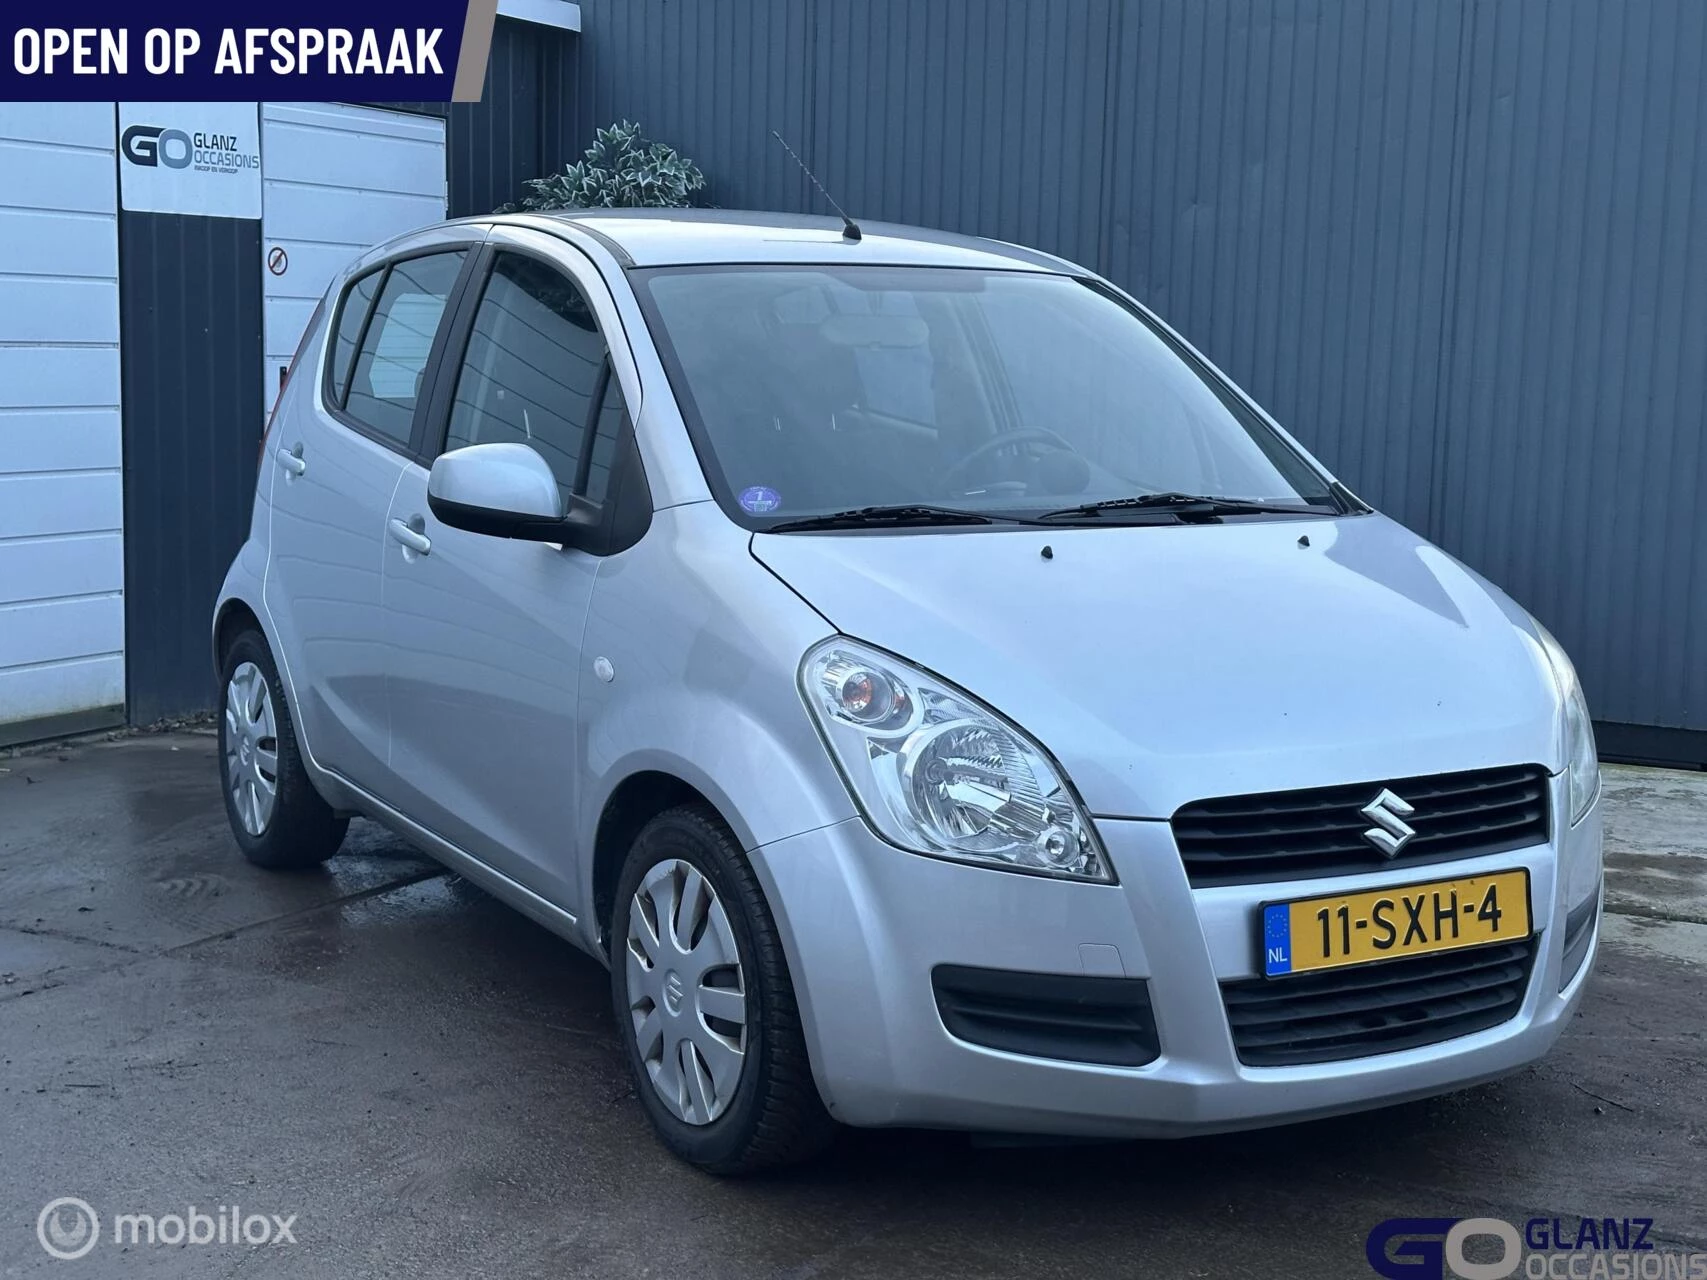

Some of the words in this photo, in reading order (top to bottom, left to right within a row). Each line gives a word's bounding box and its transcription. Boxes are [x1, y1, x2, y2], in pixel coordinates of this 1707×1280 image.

[121, 125, 193, 169] GO
[193, 132, 237, 151] GLANZ
[194, 150, 260, 169] OCCASIONS
[1316, 882, 1501, 958] 11-SXH-4
[1268, 947, 1287, 964] NL
